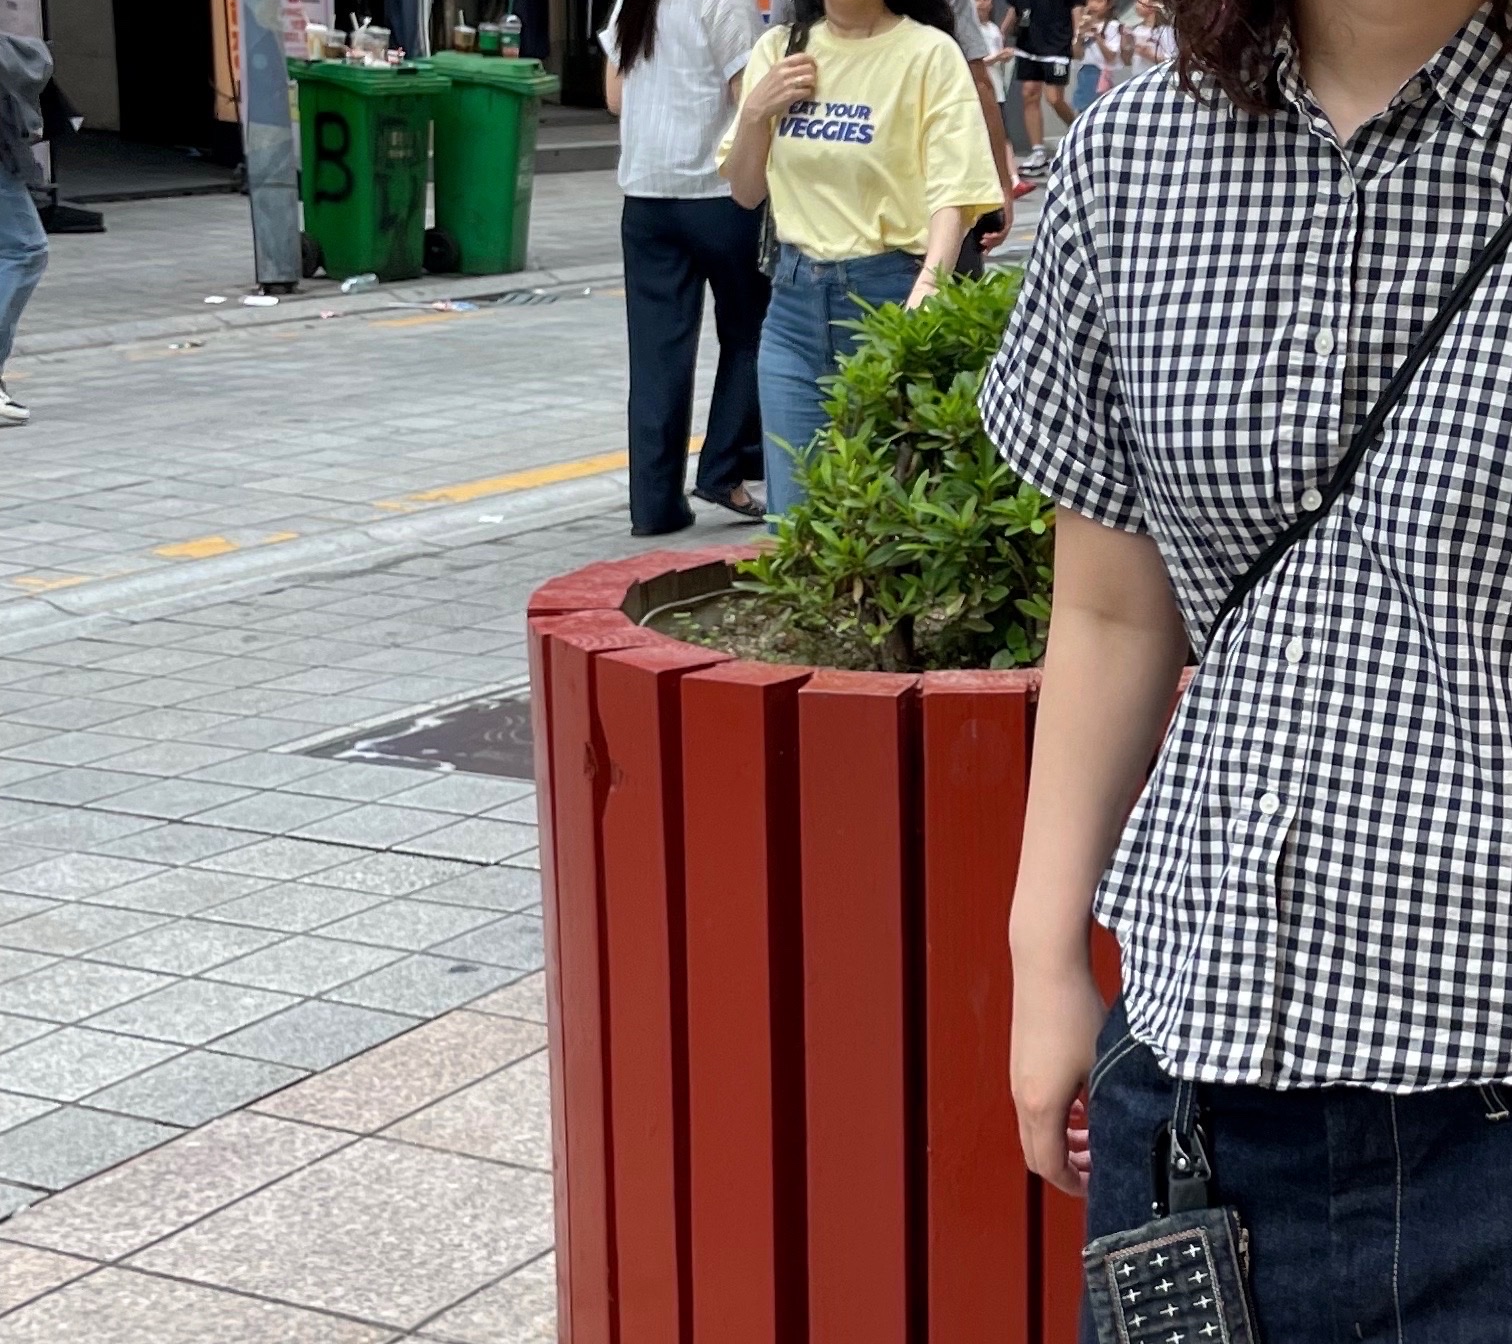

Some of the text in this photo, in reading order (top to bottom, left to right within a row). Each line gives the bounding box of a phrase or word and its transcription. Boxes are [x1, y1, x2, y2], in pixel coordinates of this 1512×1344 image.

[789, 99, 873, 121] EAT YOUR
[778, 116, 875, 145] VEGGIES
